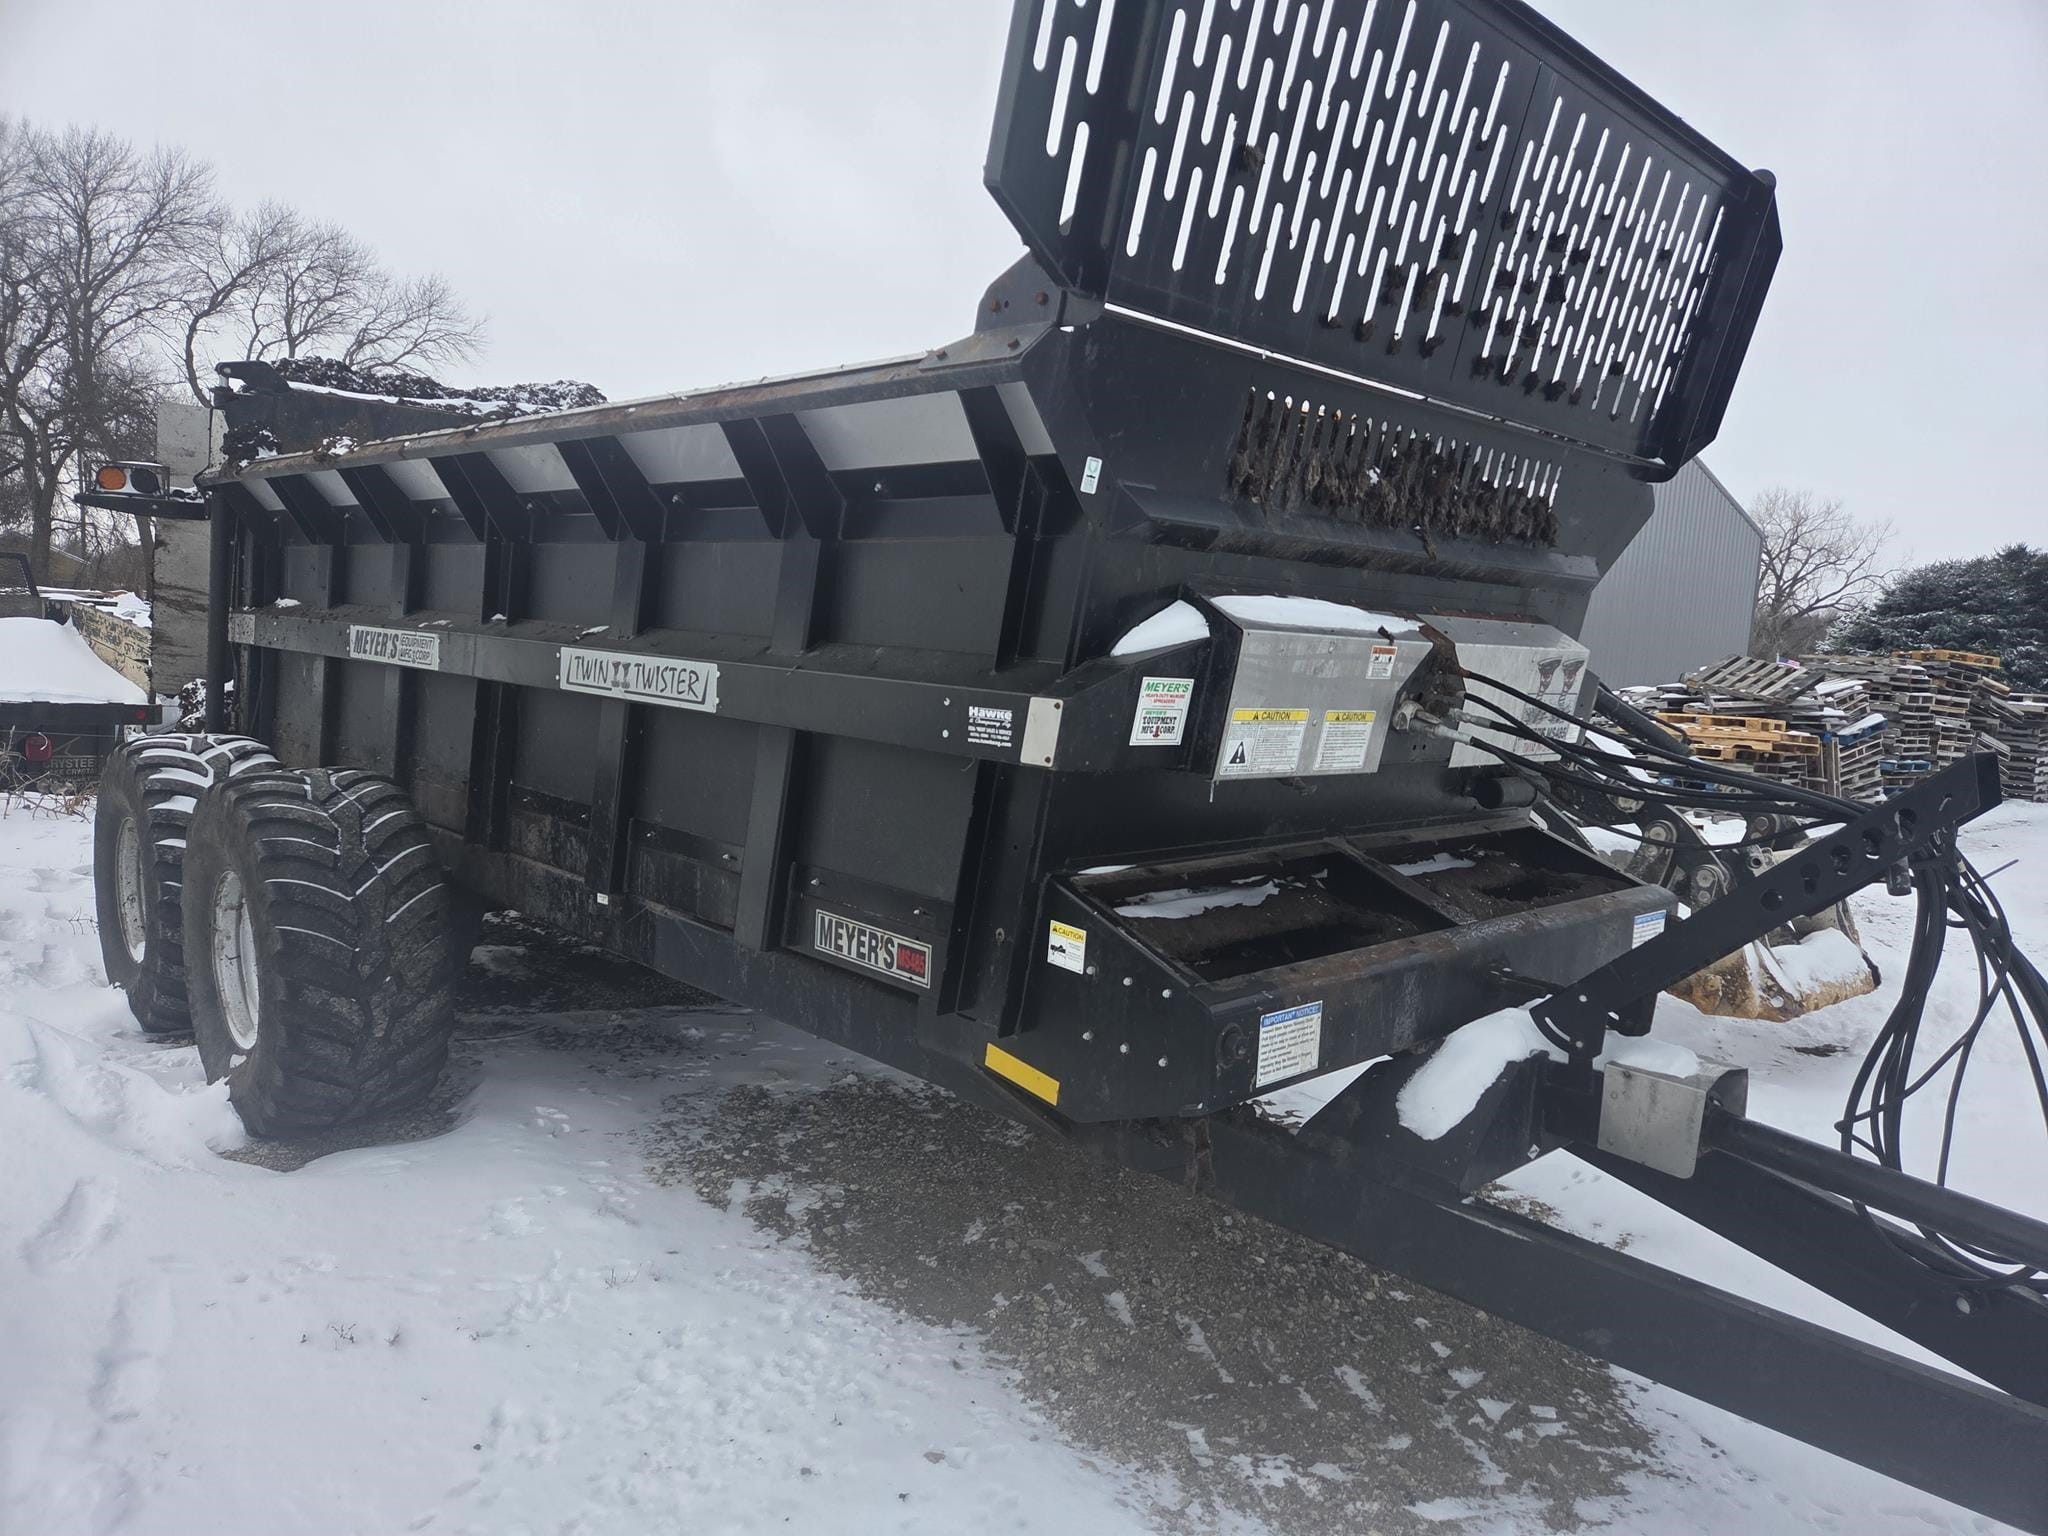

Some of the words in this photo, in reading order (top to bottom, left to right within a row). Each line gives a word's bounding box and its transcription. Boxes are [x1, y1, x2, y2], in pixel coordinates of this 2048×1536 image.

[354, 629, 399, 659] MEYER'S
[401, 636, 433, 649] EQUIPMENT
[574, 655, 609, 685] TWIN
[634, 663, 700, 699] TWISTER
[1145, 682, 1189, 692] MEYER'S
[968, 706, 1013, 721] Hawke
[1261, 711, 1291, 720] CAUTION
[1342, 713, 1367, 721] CAUTION
[44, 758, 96, 768] CRYSTEE
[1057, 927, 1084, 941] CAUTION
[820, 915, 896, 970] MEYER'S
[1263, 1010, 1297, 1026] IMPORTANT
